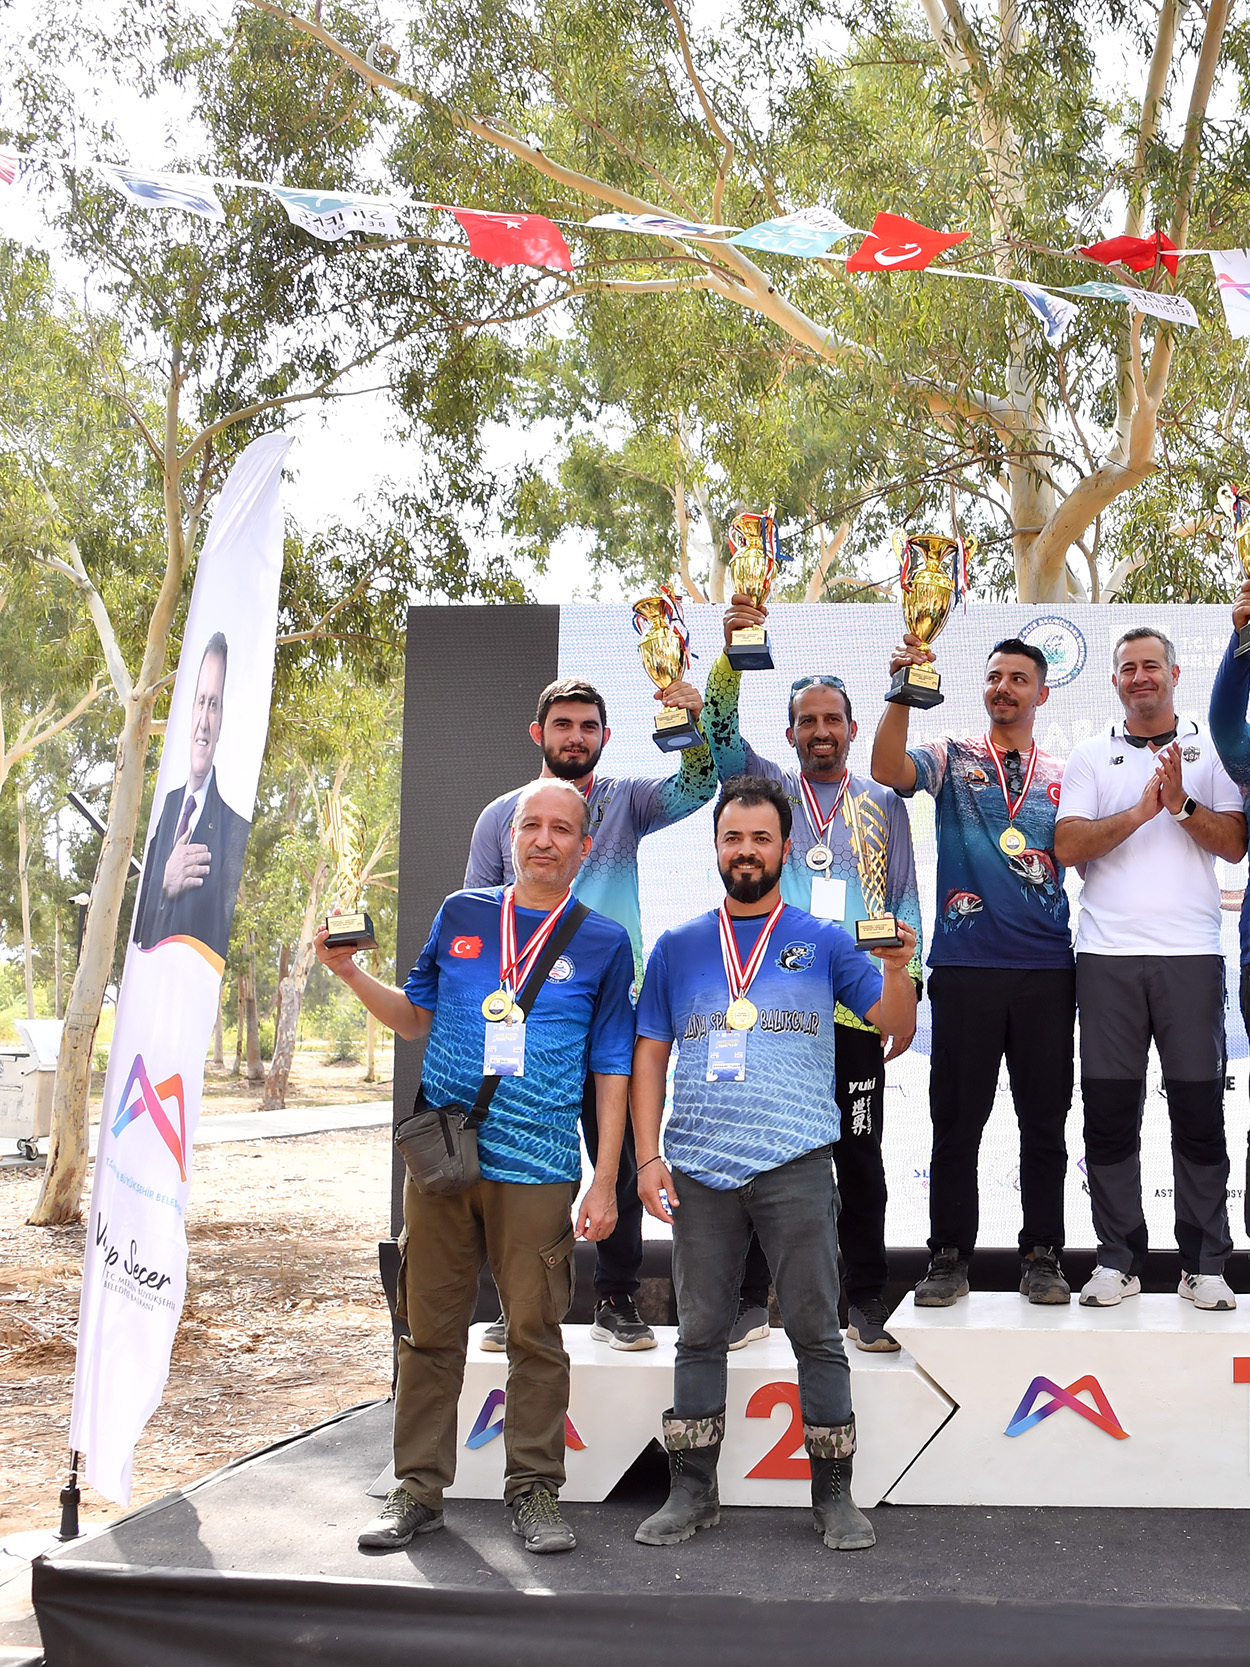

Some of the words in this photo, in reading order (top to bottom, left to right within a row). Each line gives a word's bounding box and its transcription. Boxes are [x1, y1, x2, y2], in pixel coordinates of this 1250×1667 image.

[848, 1077, 876, 1095] yuki
[124, 1239, 171, 1291] Seçer
[745, 1381, 812, 1480] 2
